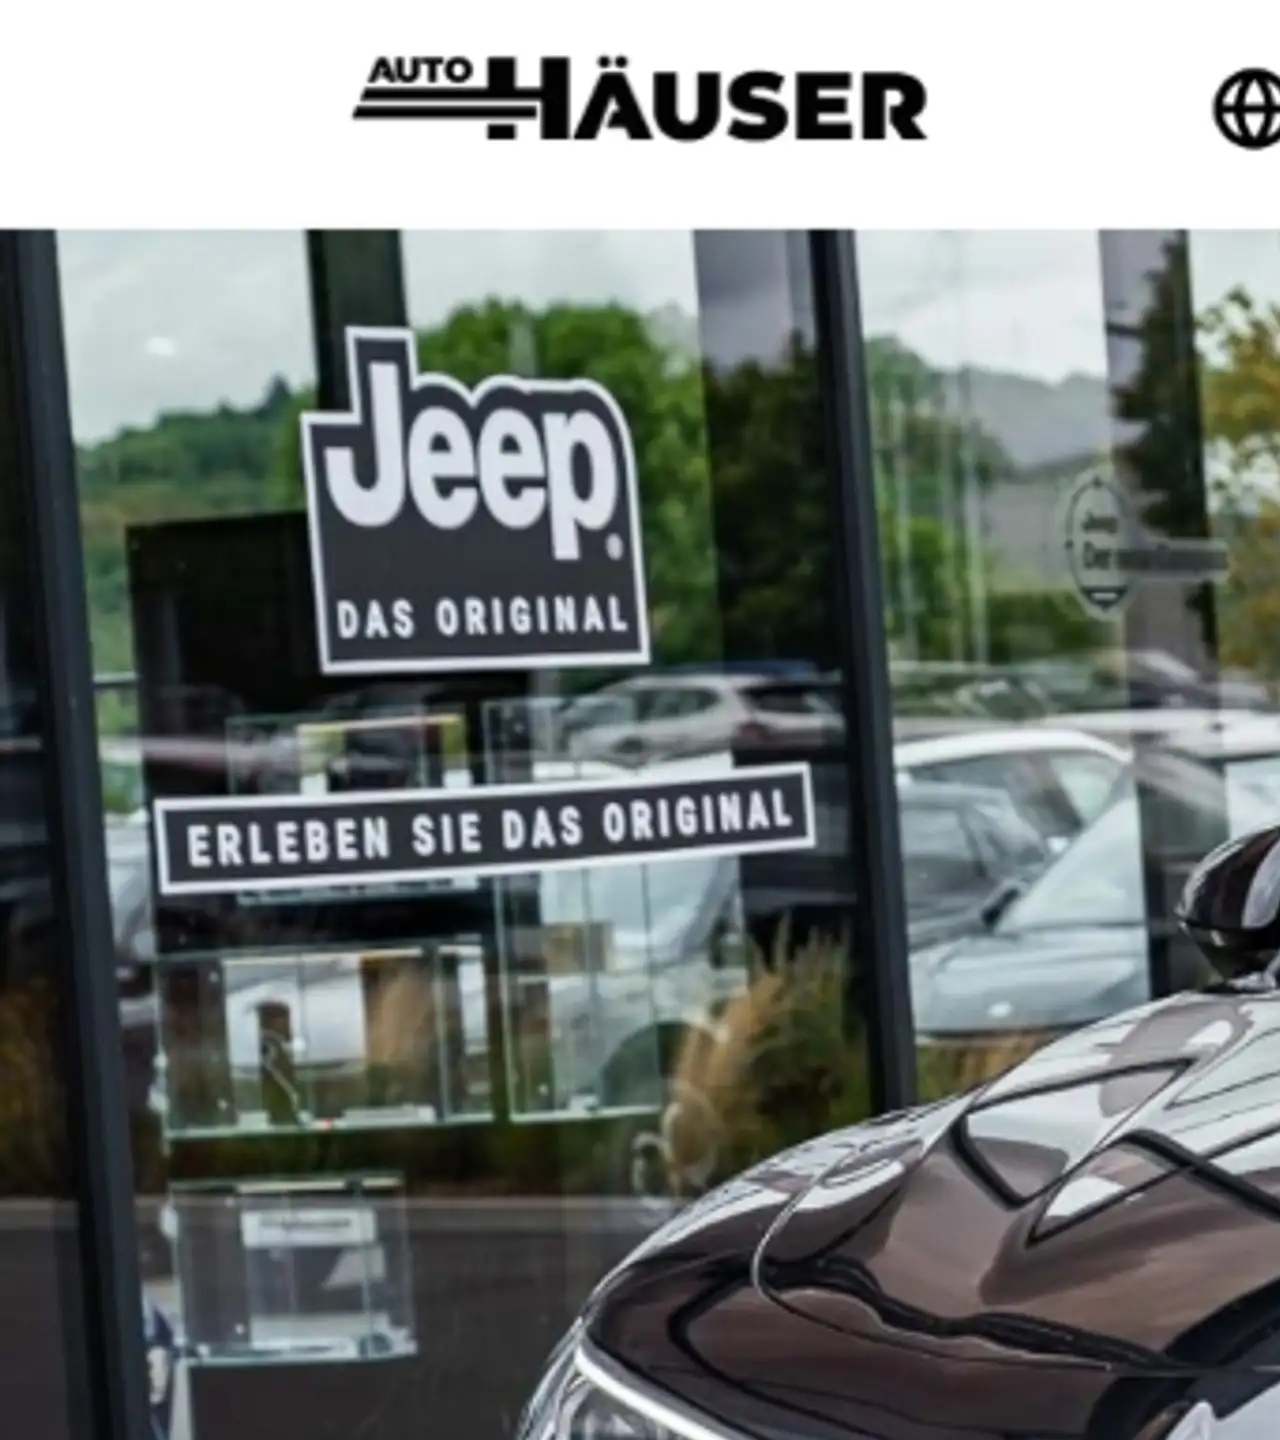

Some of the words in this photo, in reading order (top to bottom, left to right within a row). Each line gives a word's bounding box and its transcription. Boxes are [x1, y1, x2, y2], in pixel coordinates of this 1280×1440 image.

[324, 362, 619, 560] Jeep
[336, 598, 415, 639] DAS
[434, 593, 629, 636] ORIGINAL
[186, 817, 391, 867] ERLEBEN
[412, 813, 483, 855] SIE
[503, 806, 582, 850] DAS
[603, 789, 793, 841] ORIGINAL
